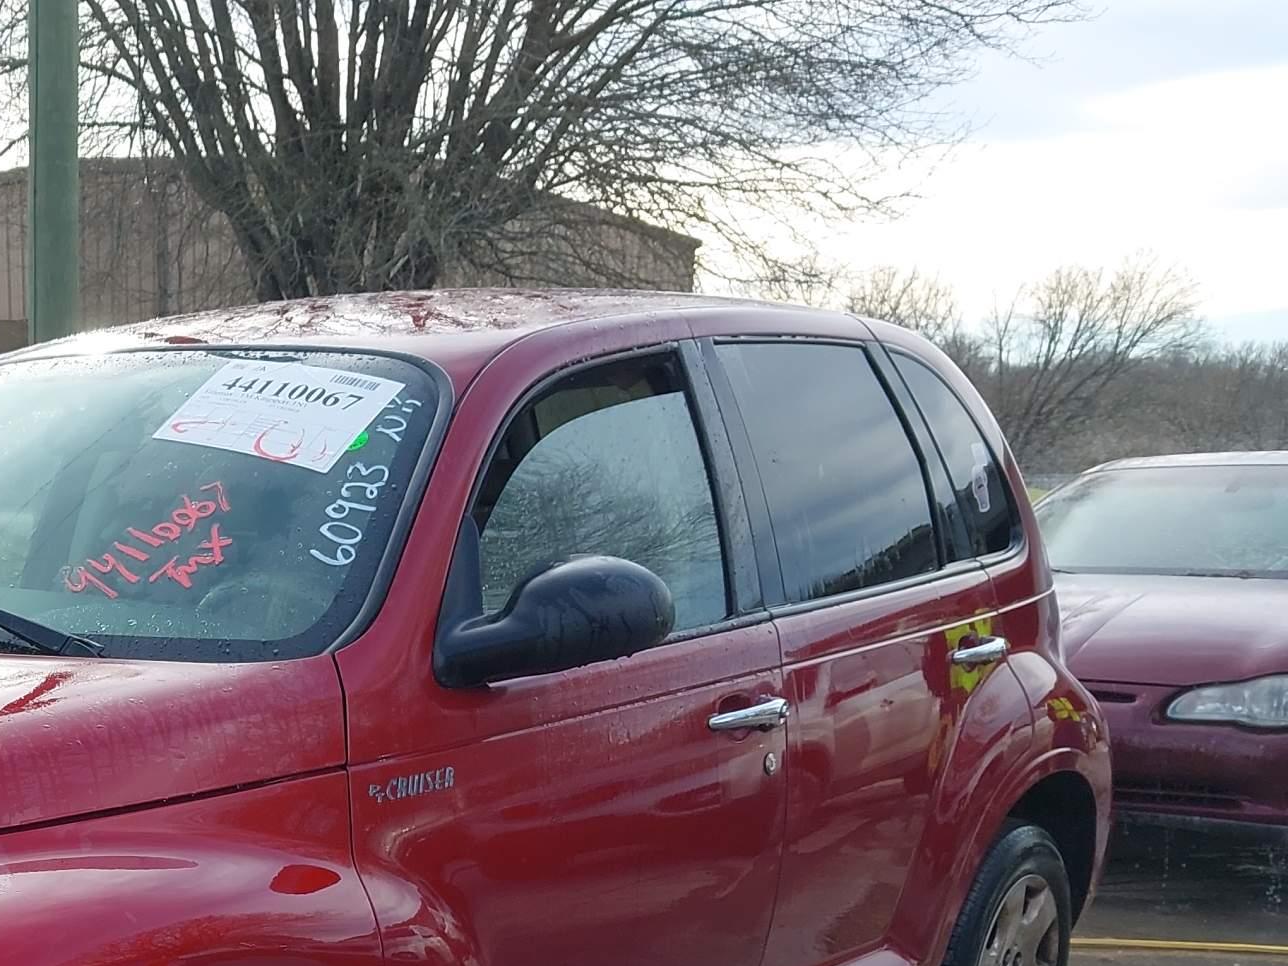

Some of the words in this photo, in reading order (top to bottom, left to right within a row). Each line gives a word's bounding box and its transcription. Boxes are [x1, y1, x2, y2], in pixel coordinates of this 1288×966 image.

[222, 375, 364, 411] 44110067
[310, 461, 389, 566] 60923
[386, 766, 454, 801] CRUISER
